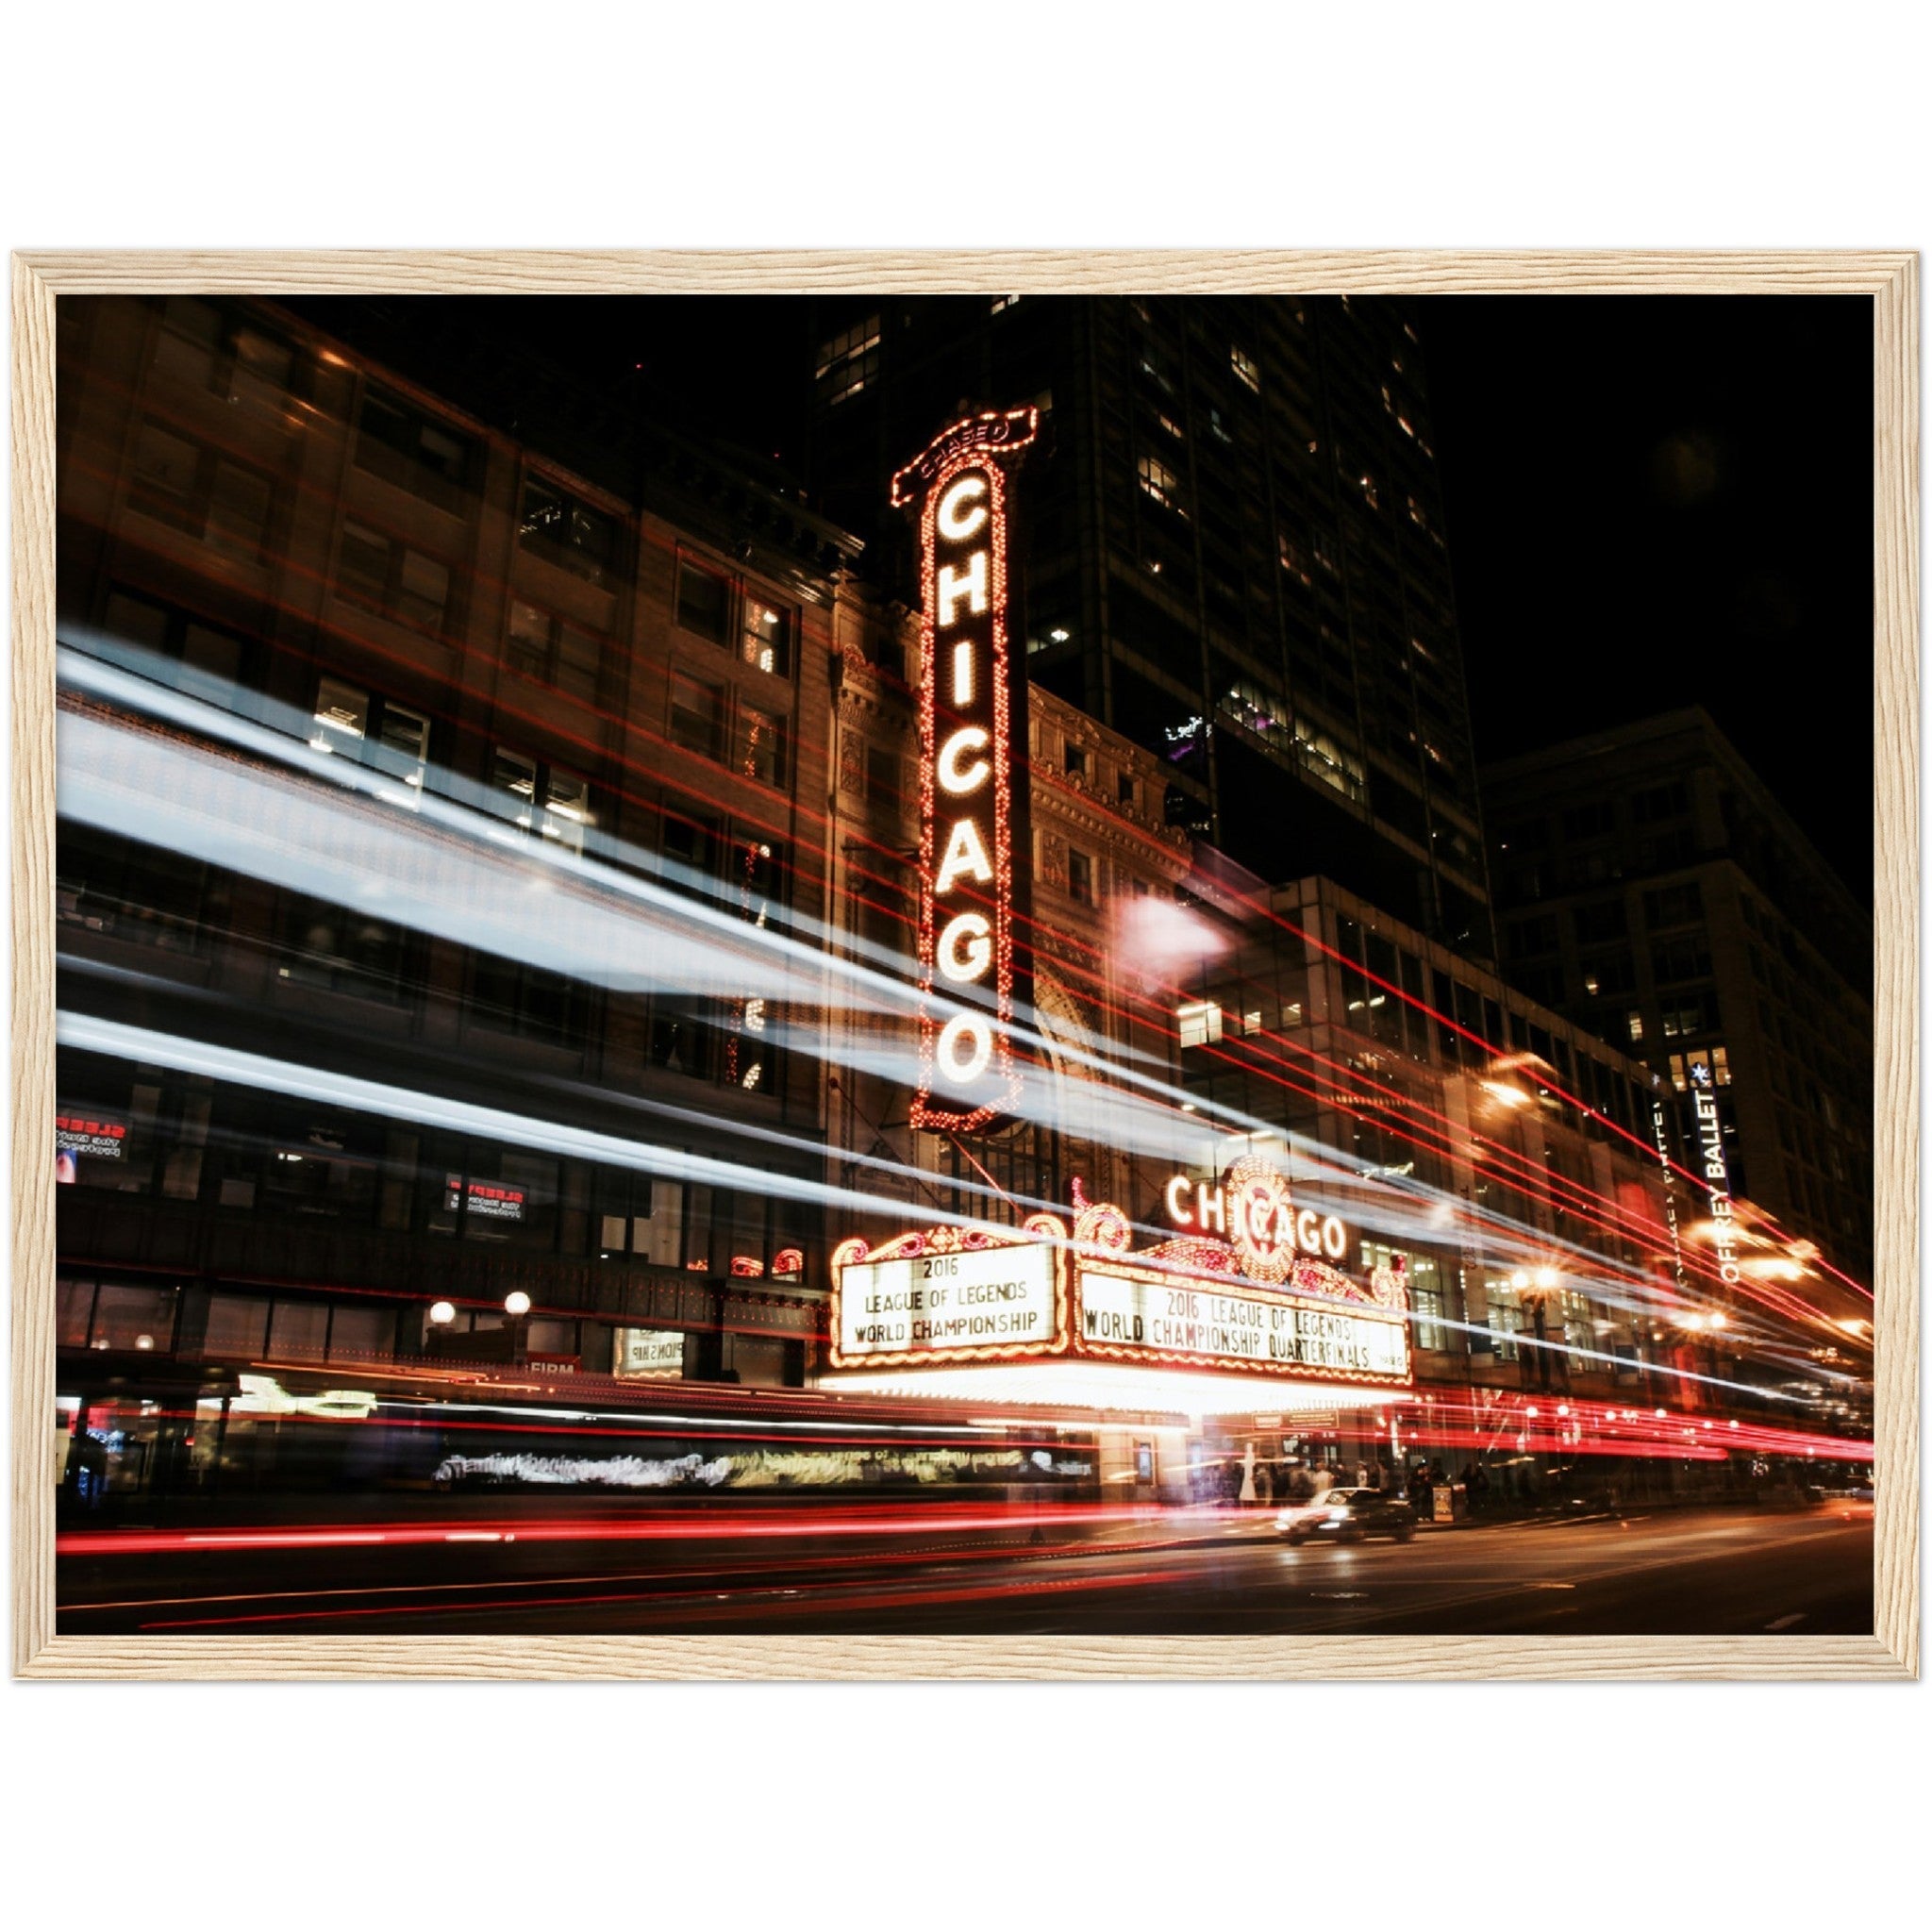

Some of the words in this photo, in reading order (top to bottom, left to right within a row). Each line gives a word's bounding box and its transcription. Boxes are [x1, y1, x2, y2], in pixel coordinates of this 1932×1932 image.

[935, 475, 993, 1084] CHICAGO
[1694, 1089, 1727, 1179] BALLET
[1166, 1174, 1346, 1259] CHICAGO
[924, 1257, 958, 1278] 2016
[865, 1291, 924, 1313] LEAGUE
[929, 1289, 948, 1307] OF
[958, 1281, 1027, 1306] LEGENDS
[1167, 1291, 1199, 1319] 2016
[1210, 1297, 1264, 1328] LEAGUE
[1272, 1307, 1287, 1331] OF
[1295, 1311, 1351, 1341] LEGENDS
[856, 1323, 905, 1343] WORLD
[912, 1312, 1038, 1341] CHAMPIONSHIP
[1084, 1308, 1143, 1341] WORLD
[1153, 1319, 1260, 1355] CHAMPIONSHIP
[1269, 1334, 1369, 1368] QUARTERFINALS
